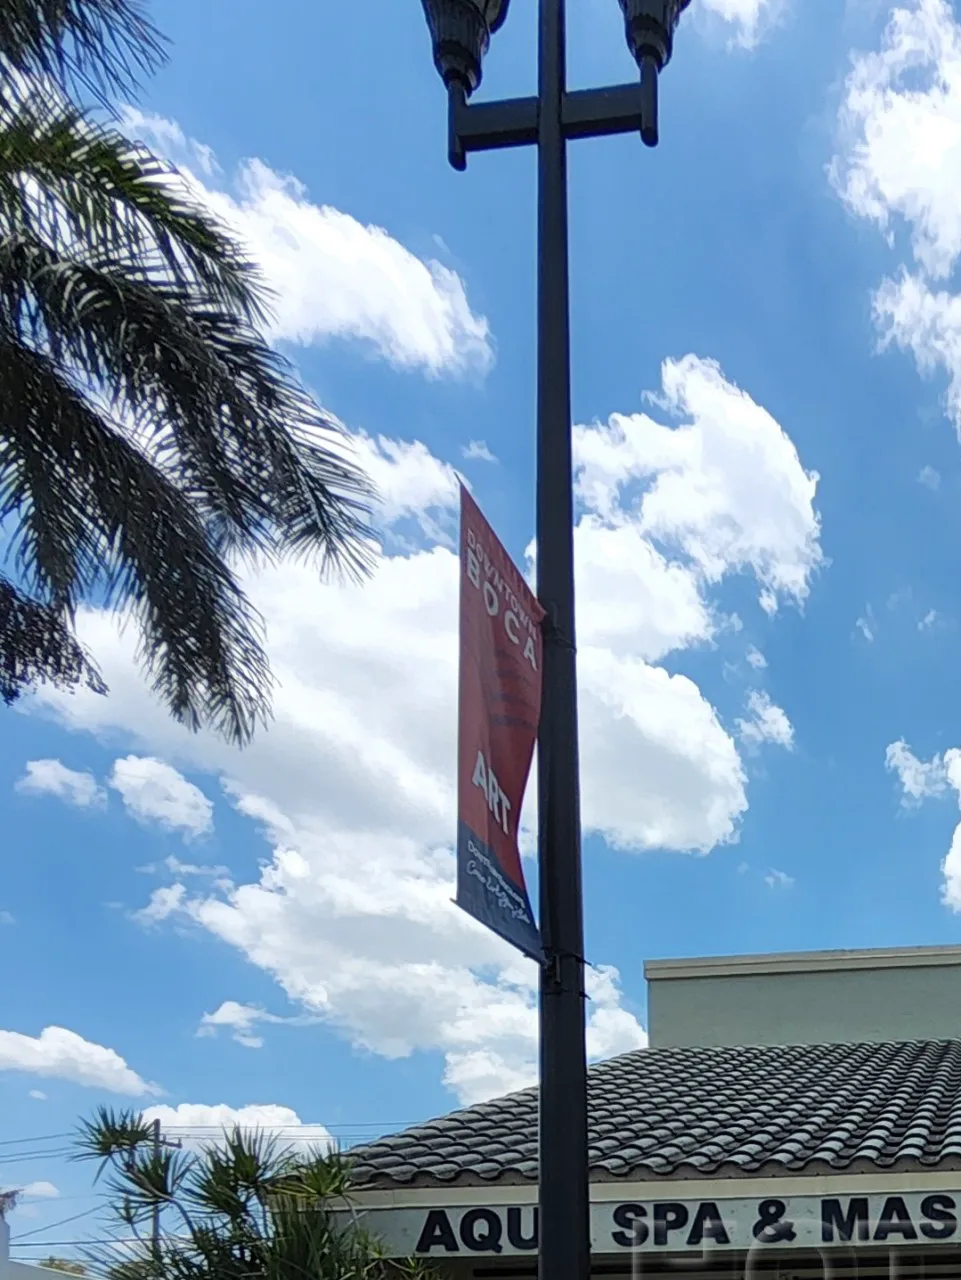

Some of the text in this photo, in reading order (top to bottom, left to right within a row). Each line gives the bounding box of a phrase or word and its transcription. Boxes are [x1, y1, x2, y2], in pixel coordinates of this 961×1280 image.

[467, 528, 537, 641] DOWNTOWN
[467, 548, 538, 672] BOCA
[472, 750, 512, 835] ART
[415, 1207, 591, 1253] AQU
[611, 1202, 730, 1248] SPA
[753, 1199, 796, 1243] &
